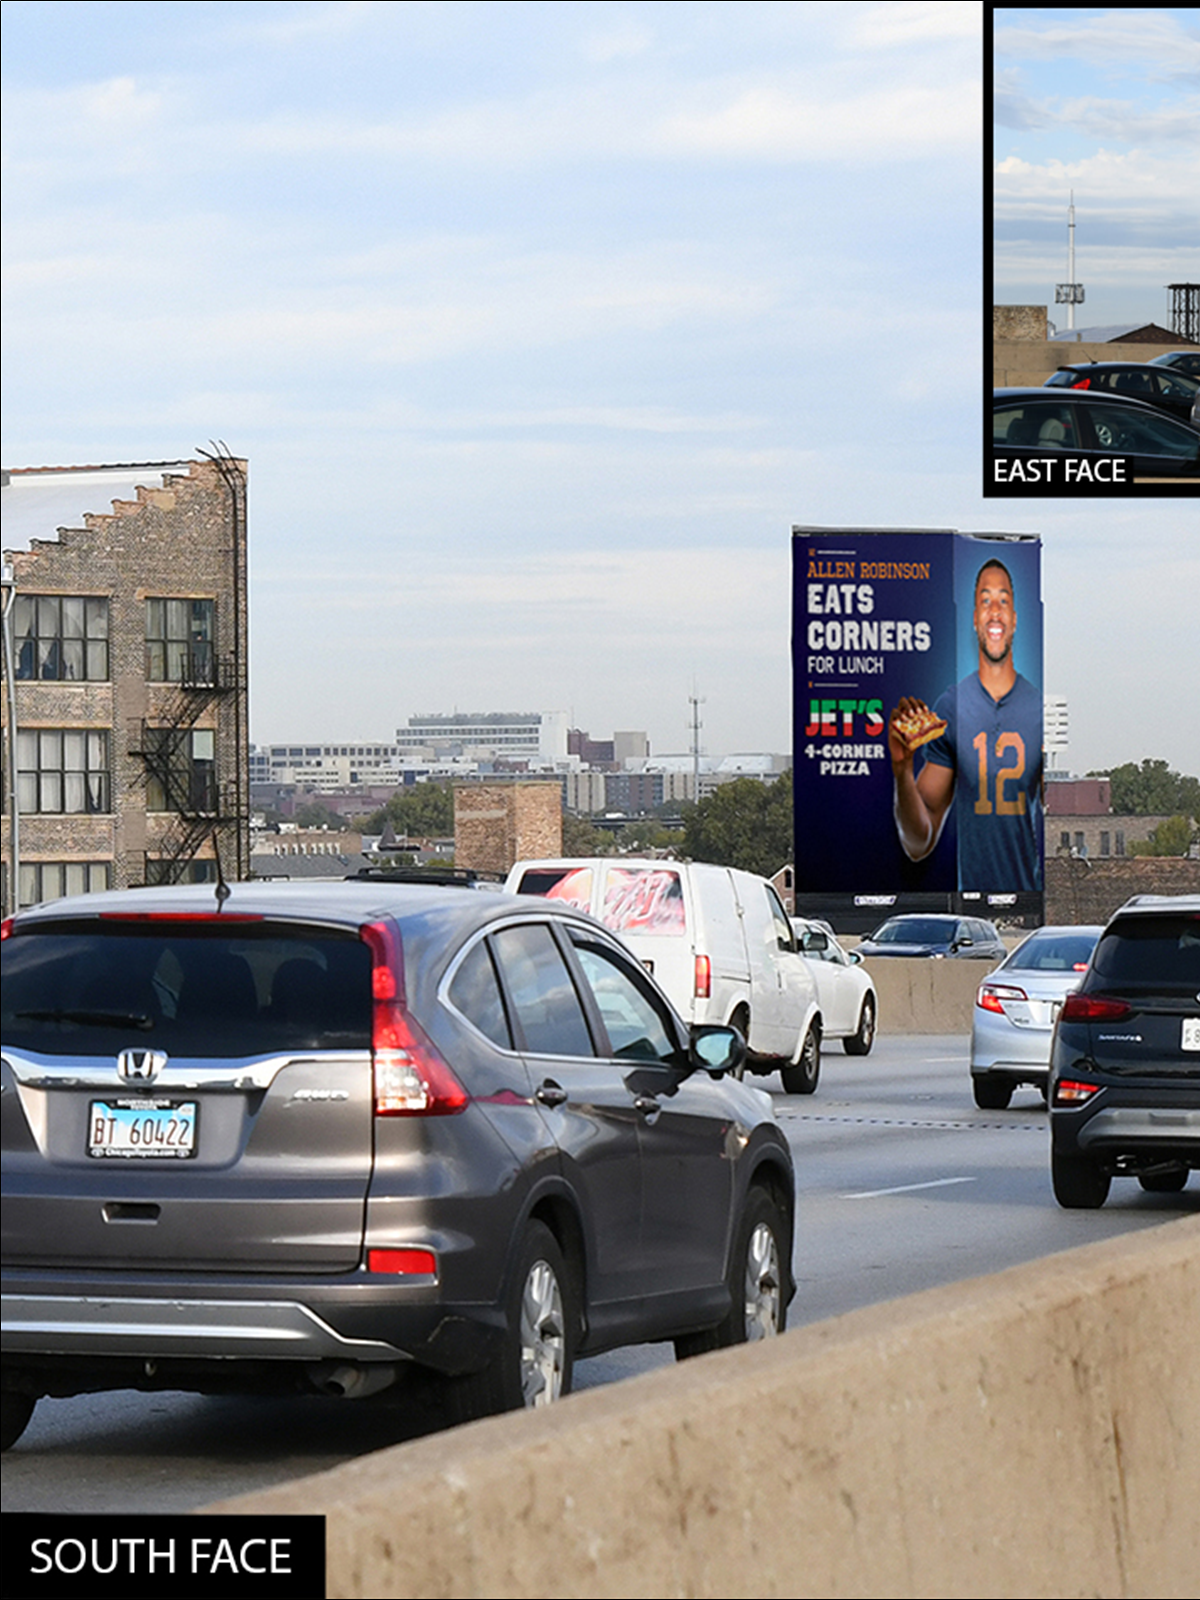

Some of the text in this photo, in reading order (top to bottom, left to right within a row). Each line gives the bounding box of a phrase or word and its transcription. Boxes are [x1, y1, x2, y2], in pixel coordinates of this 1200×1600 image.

[807, 561, 931, 579] ALLEN ROBINSON
[807, 583, 874, 615] EATS
[807, 620, 931, 651] CORNERS
[807, 655, 884, 674] FOR LUNCH
[805, 699, 885, 738] JET'S
[804, 743, 885, 759] 4-CORNER
[820, 761, 871, 776] PIZZA
[973, 731, 1027, 816] 12
[93, 1117, 191, 1146] BT 60422
